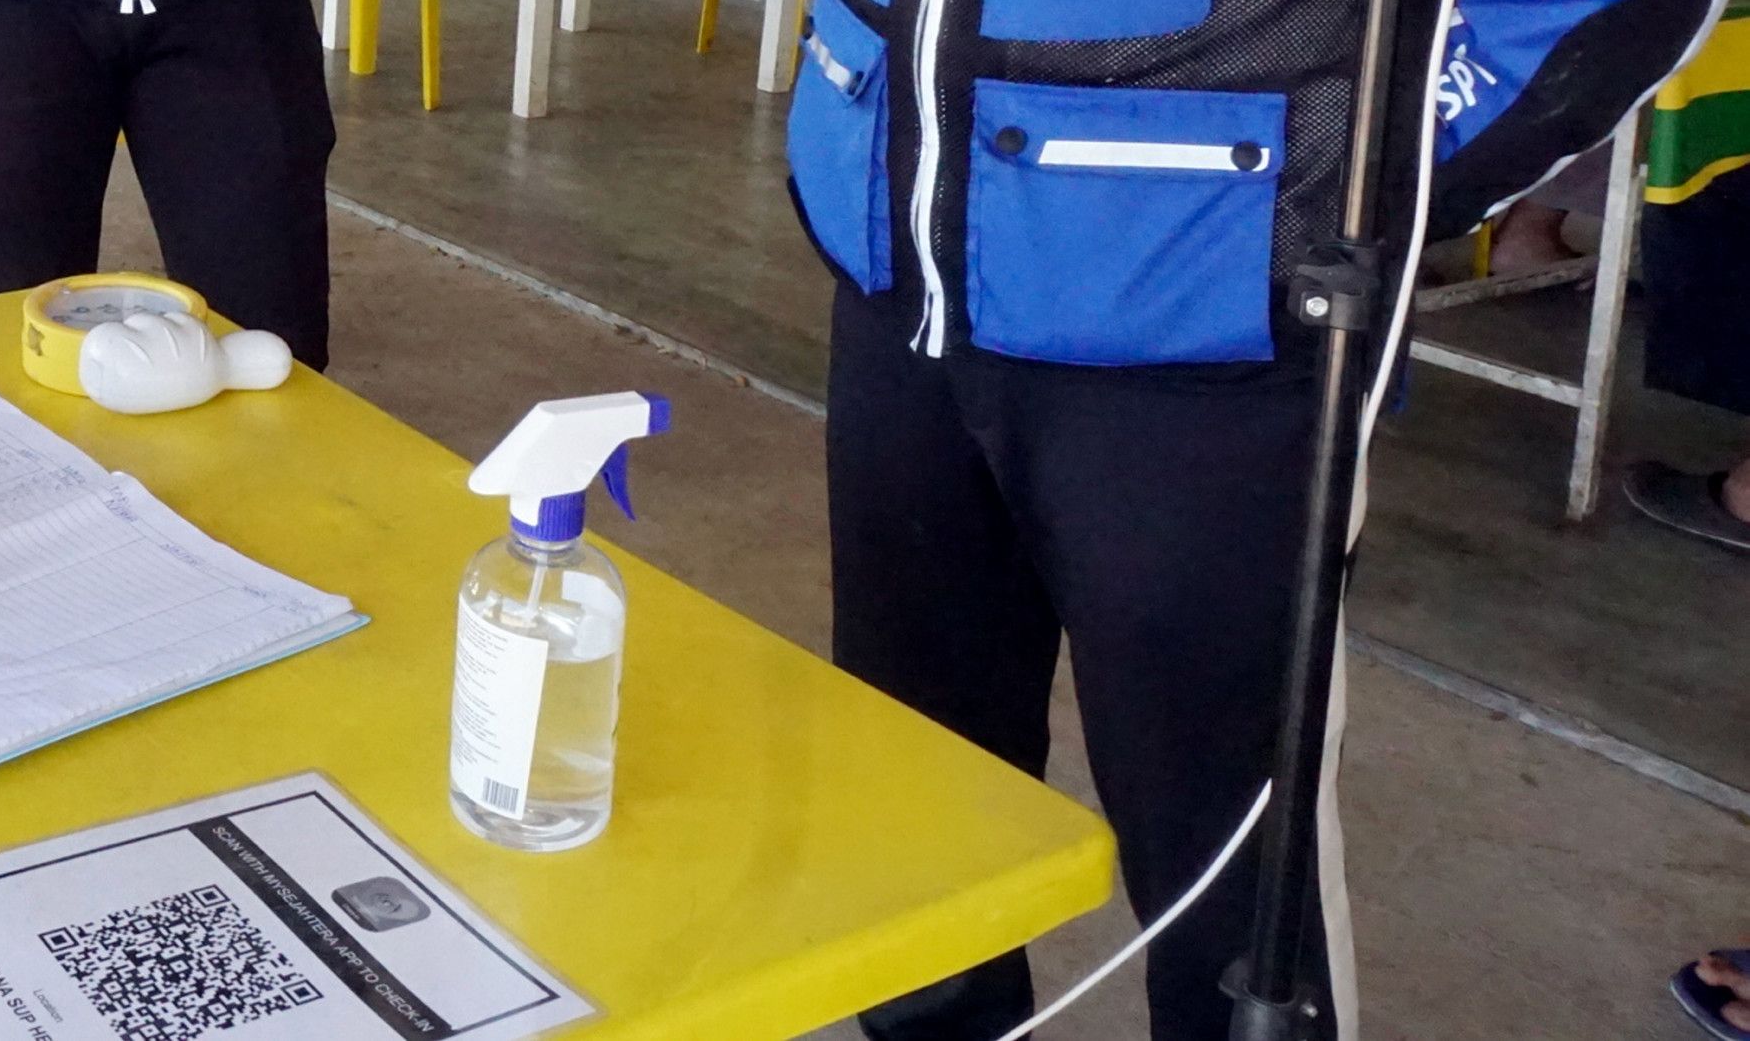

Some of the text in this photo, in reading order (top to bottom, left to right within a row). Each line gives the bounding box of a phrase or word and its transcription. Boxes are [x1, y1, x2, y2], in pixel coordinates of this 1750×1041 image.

[212, 826, 244, 853] SCAN
[239, 849, 269, 875] WITH
[264, 873, 337, 947] MYSEJAHTERA
[335, 944, 362, 970] APP
[358, 966, 377, 984] TO
[374, 982, 435, 1034] CHECK-IN
[7, 997, 36, 1024] SUP
